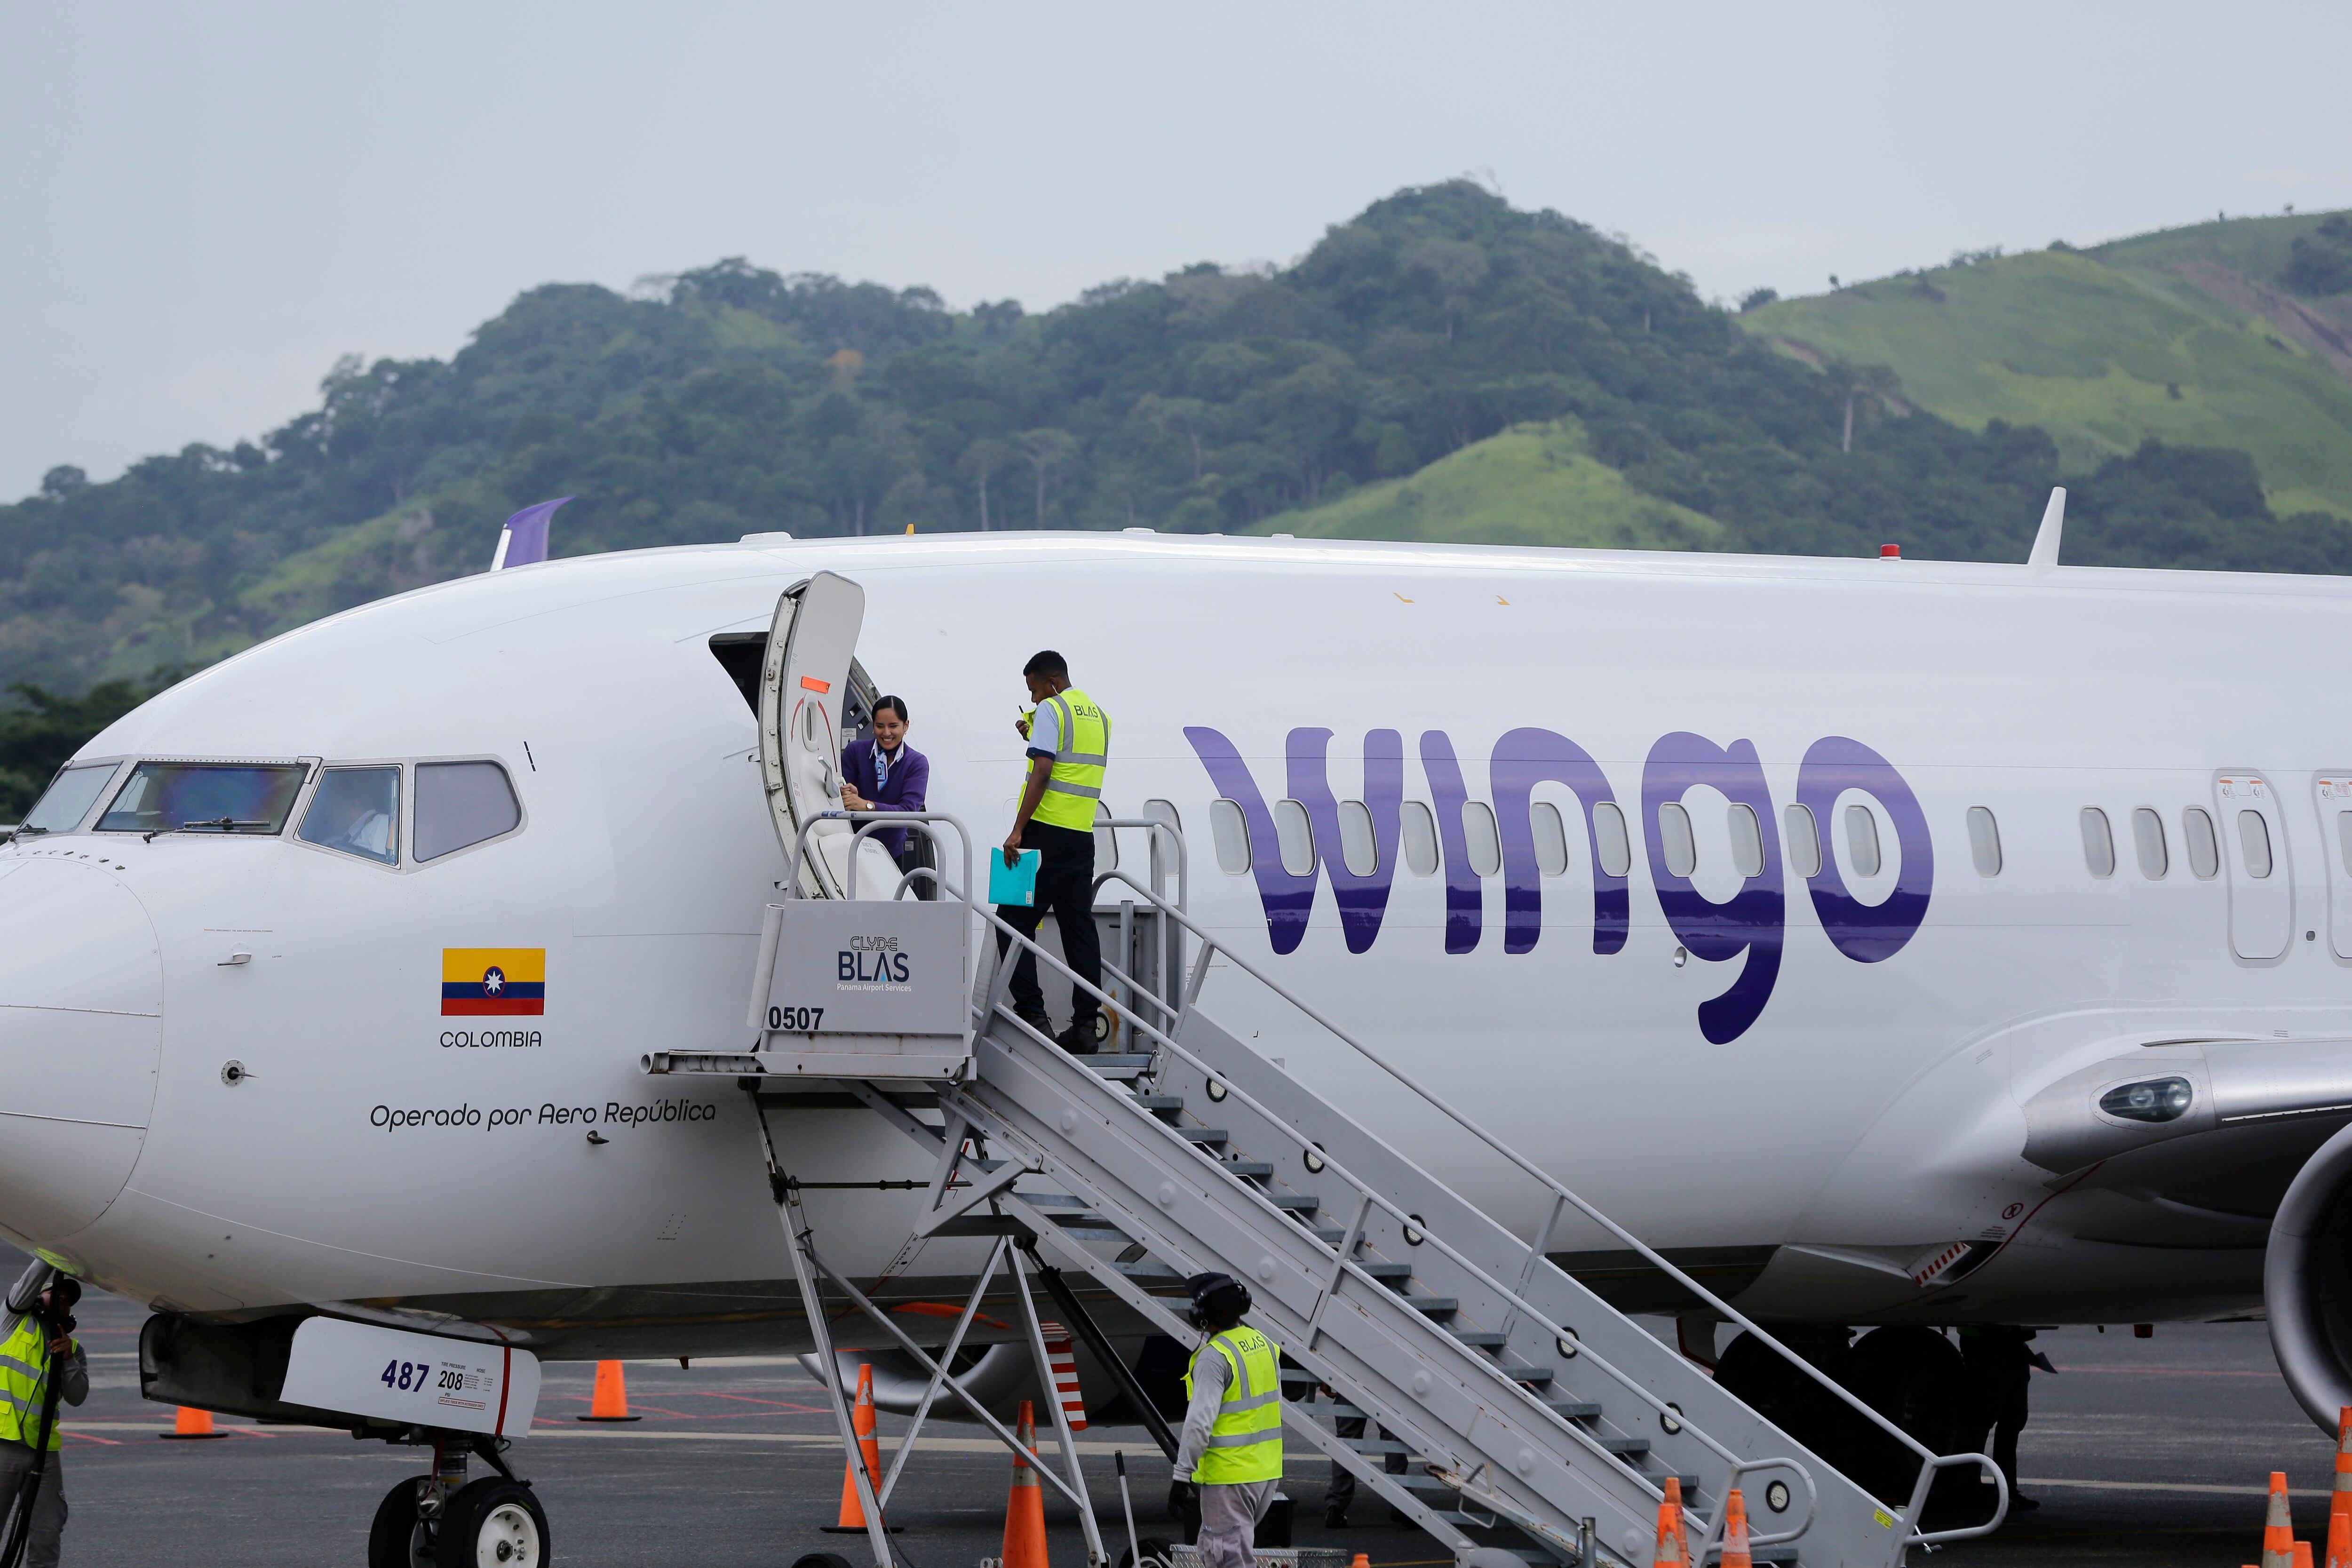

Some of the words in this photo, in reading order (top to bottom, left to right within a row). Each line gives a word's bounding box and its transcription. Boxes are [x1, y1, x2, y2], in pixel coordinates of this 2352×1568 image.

[1073, 705, 1098, 718] BLAS
[1183, 726, 1934, 1045] wingo
[850, 936, 898, 951] CLYDE
[838, 951, 910, 983] BLAS
[863, 983, 884, 993] Airport
[769, 1006, 824, 1030] 0507
[440, 1031, 541, 1048] COLOMBIA
[370, 1103, 481, 1132] Operado
[487, 1108, 532, 1131] por
[538, 1103, 597, 1124] Aero
[604, 1099, 716, 1128] República
[1238, 1336, 1265, 1352] BLAS
[381, 1359, 430, 1393] 487
[437, 1370, 463, 1391] 208
